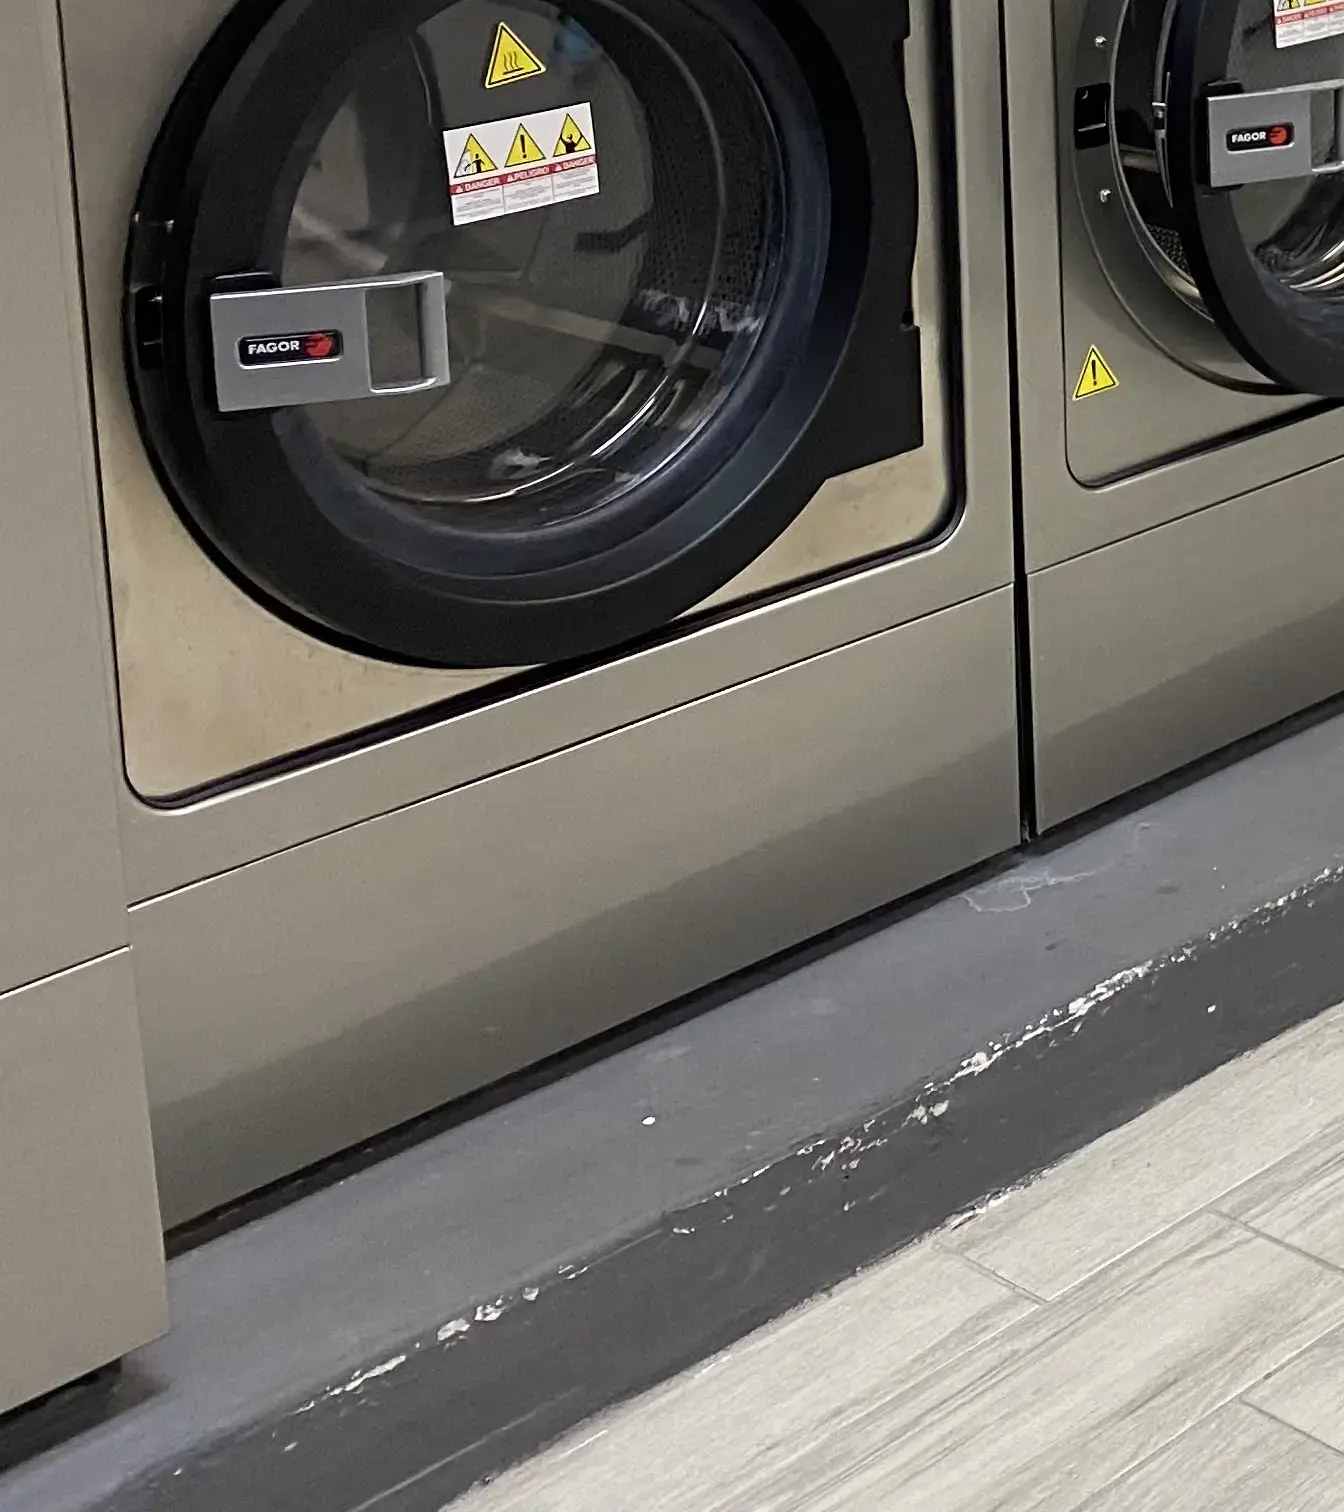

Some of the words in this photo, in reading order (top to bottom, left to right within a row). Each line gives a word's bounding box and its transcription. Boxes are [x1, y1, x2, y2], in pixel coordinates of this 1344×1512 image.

[1231, 131, 1267, 143] FAGOR
[464, 177, 500, 191] DANGER
[511, 167, 550, 182] PELIGRO
[248, 339, 300, 355] FAGOR
